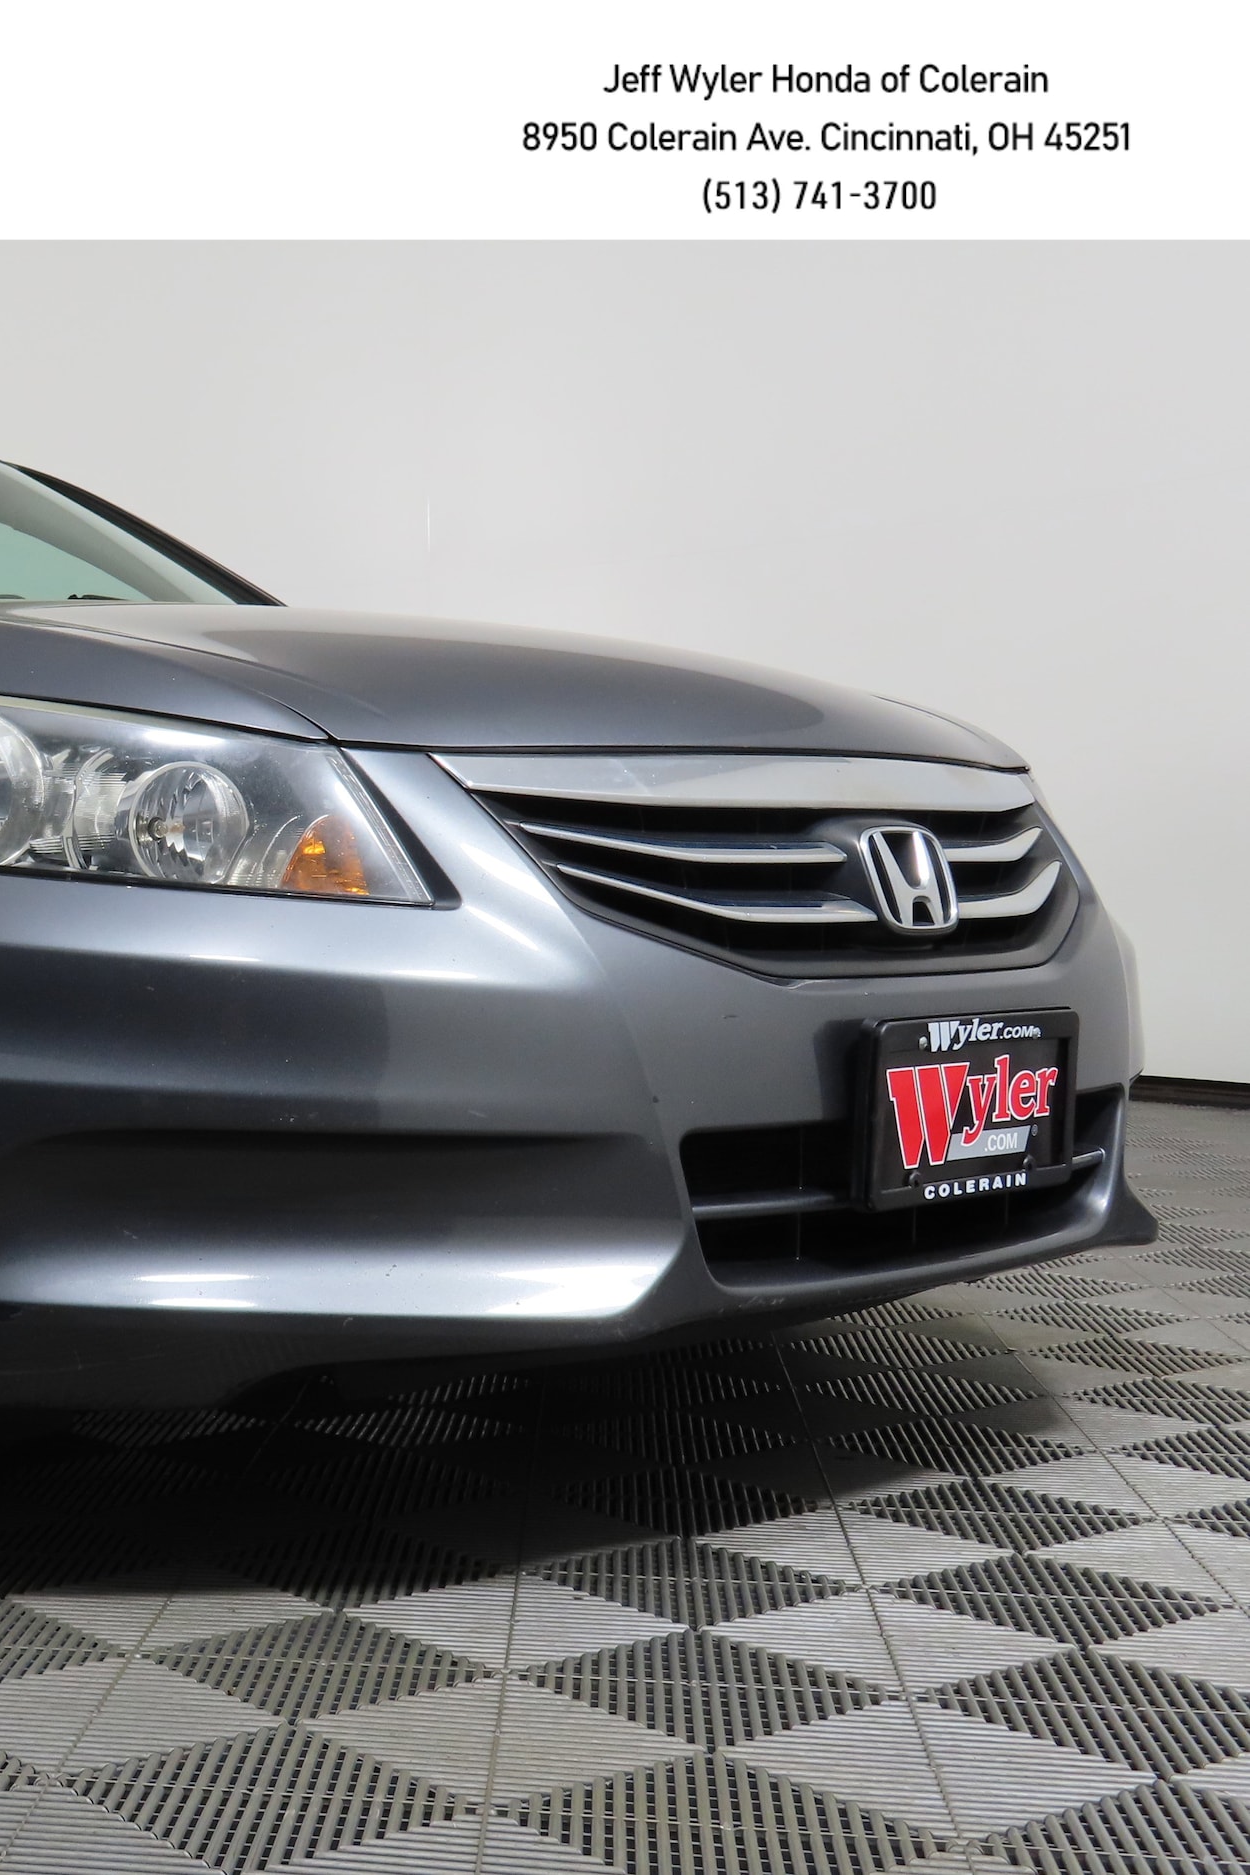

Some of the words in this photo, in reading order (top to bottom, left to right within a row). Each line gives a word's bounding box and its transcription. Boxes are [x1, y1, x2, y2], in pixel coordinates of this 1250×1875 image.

[886, 1054, 1059, 1170] Wyler
[983, 1132, 1019, 1153] .COM
[923, 1171, 1028, 1200] COLERAIN
